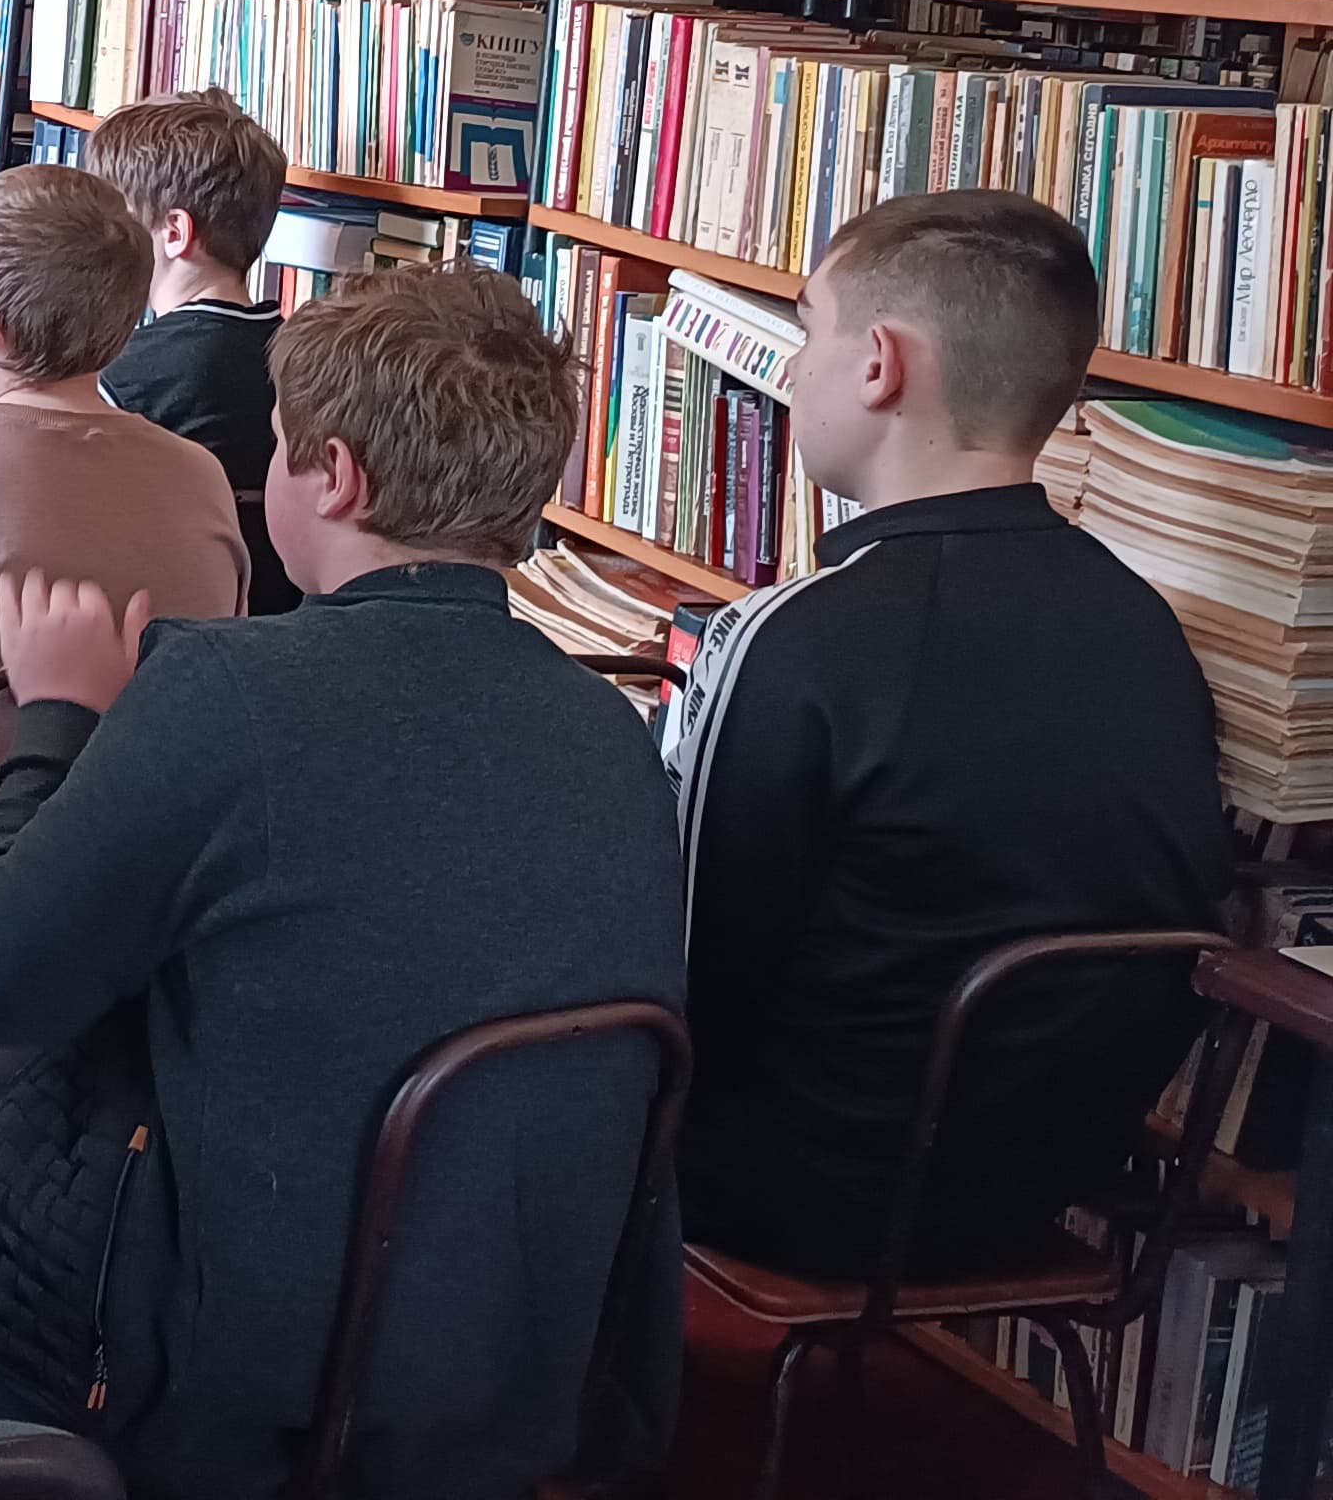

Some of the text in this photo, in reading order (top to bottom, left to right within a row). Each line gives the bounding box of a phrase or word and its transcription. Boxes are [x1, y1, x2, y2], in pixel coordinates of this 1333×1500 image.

[476, 34, 543, 55] КНИГУ
[949, 94, 964, 189] НТОНИО ГАЛА
[1077, 102, 1099, 220] МУЗЫКА СЕГОДНЯ
[1196, 134, 1273, 154] Архитекту
[1235, 178, 1261, 305] Мир Леонардо
[708, 606, 743, 653] NIKE
[686, 682, 706, 737] NIKE
